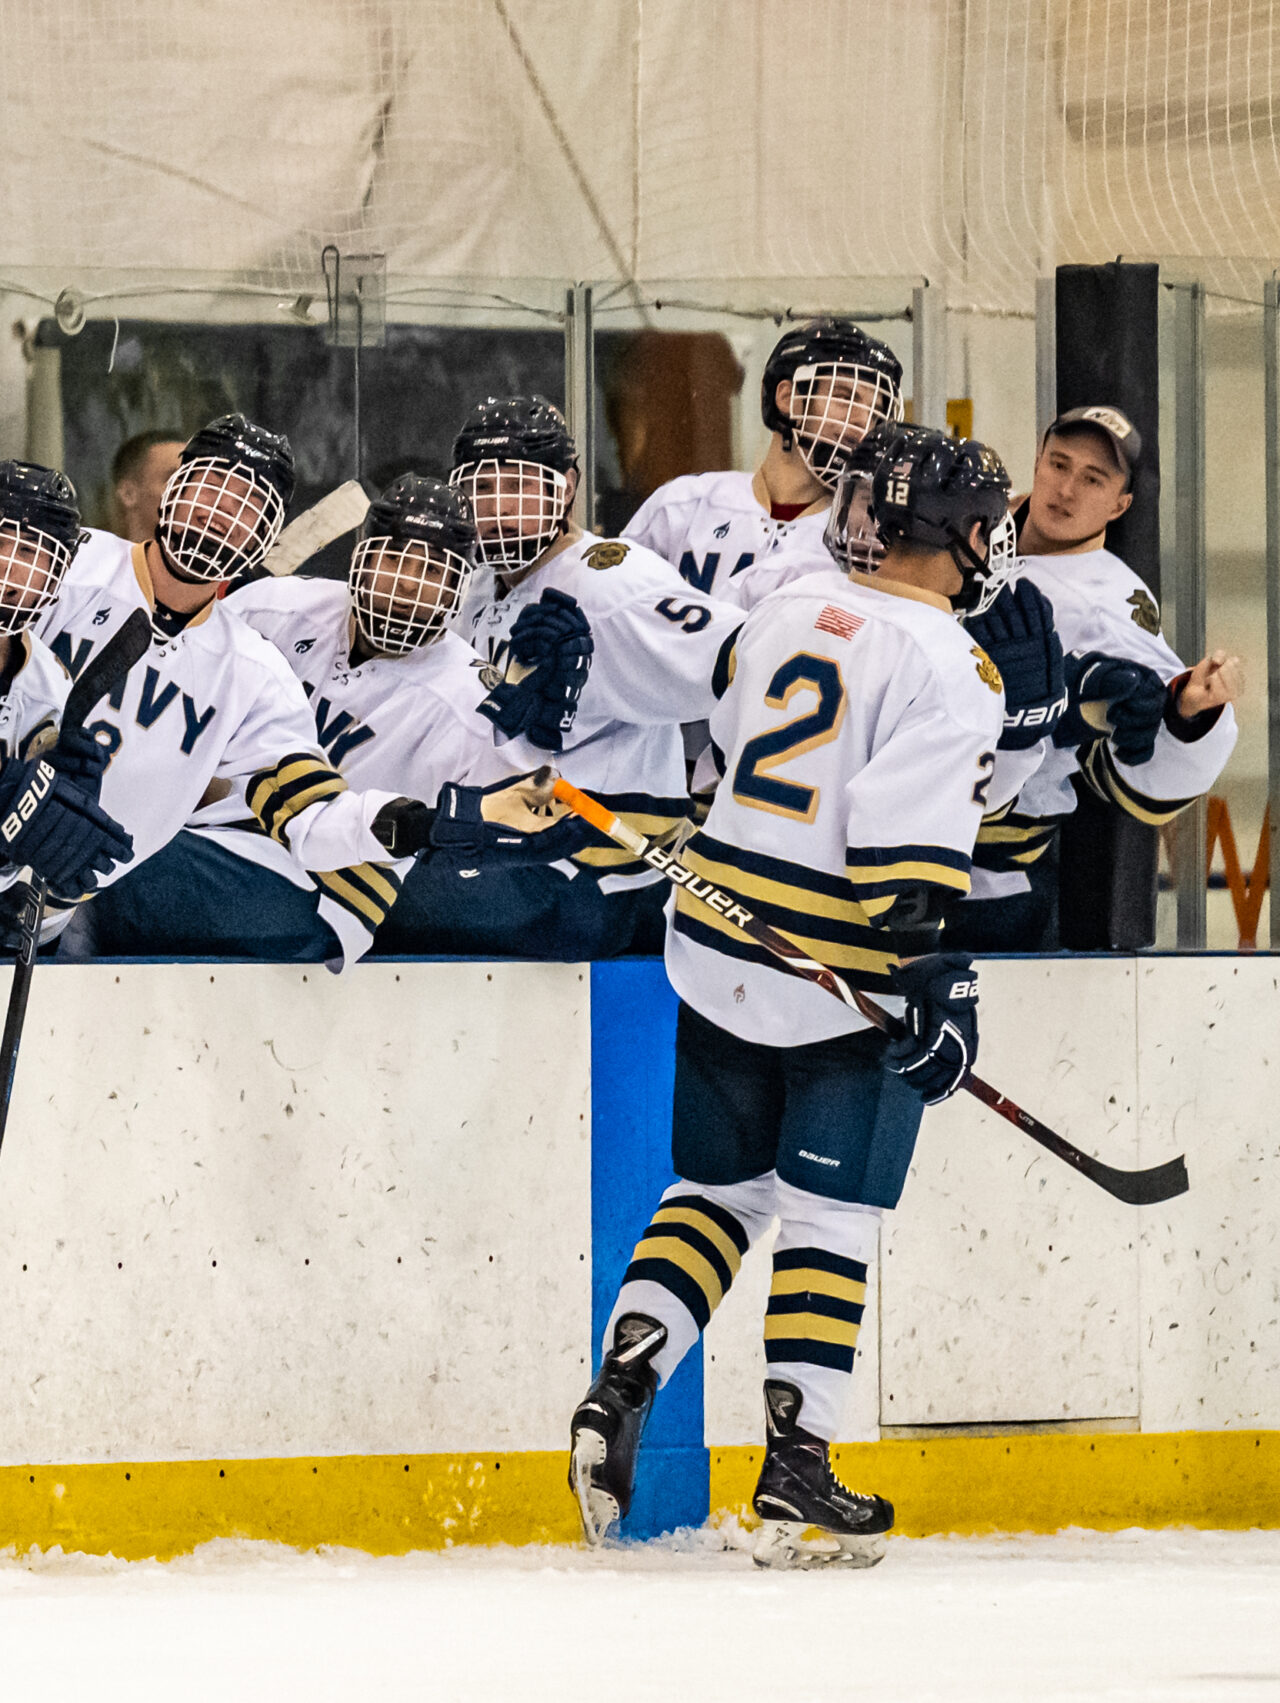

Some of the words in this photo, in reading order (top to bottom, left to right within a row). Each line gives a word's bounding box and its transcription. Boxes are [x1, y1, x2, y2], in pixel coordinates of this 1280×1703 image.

[884, 480, 909, 506] 12
[654, 597, 713, 635] 5
[731, 649, 847, 825] 2
[644, 845, 755, 928] BAUER
[798, 1149, 841, 1168] BAUER
